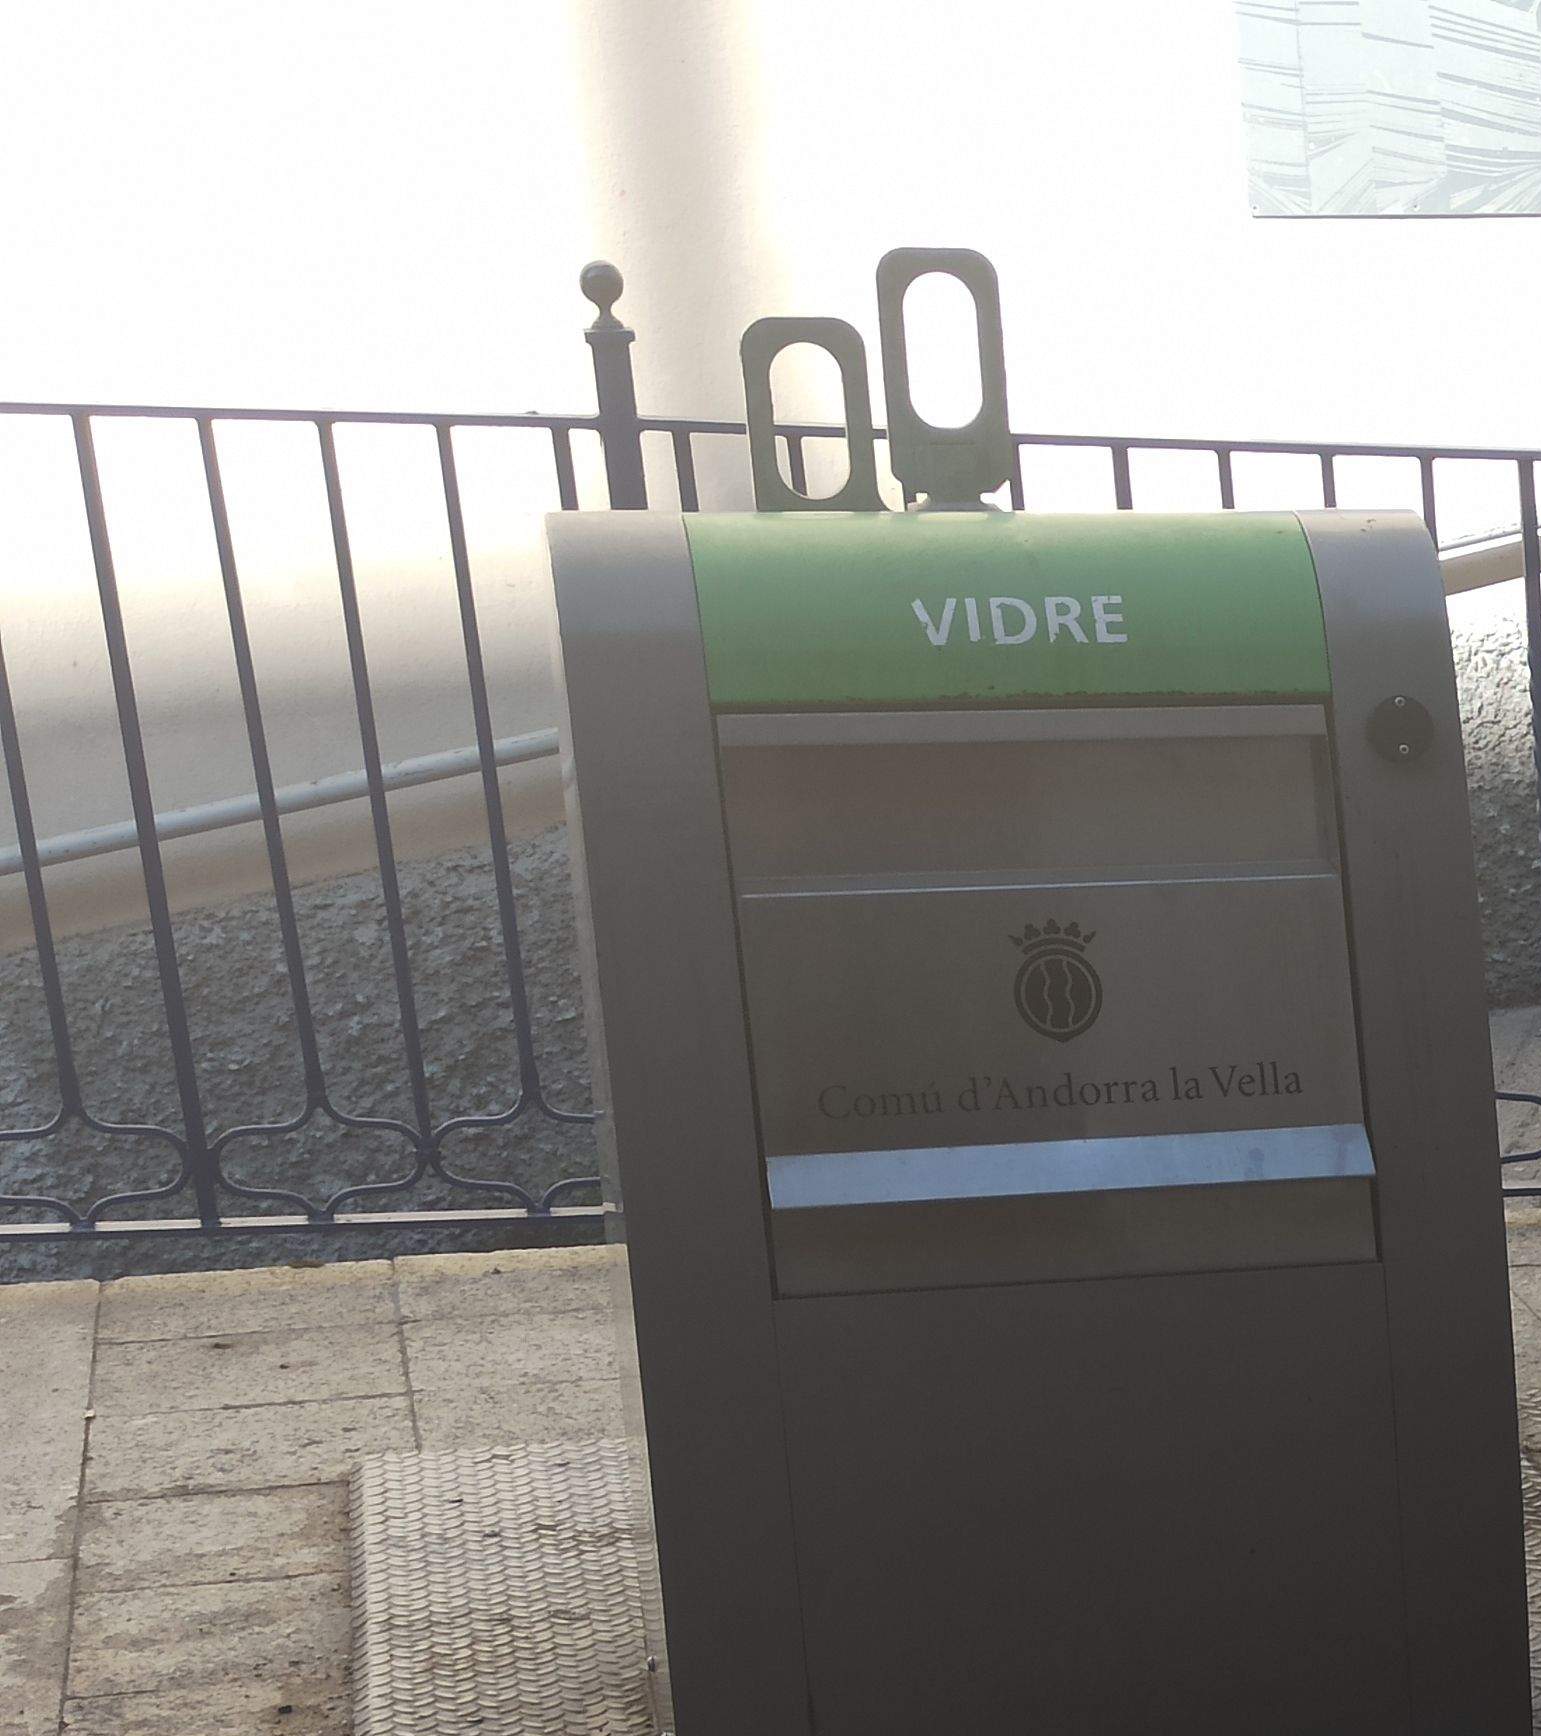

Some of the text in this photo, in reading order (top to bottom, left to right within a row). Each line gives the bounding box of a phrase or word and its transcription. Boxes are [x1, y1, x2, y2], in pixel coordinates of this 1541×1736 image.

[911, 594, 1129, 647] VIDRE
[816, 1078, 944, 1121] Comú
[1170, 1066, 1204, 1102] la
[1207, 1060, 1305, 1099] Vella
